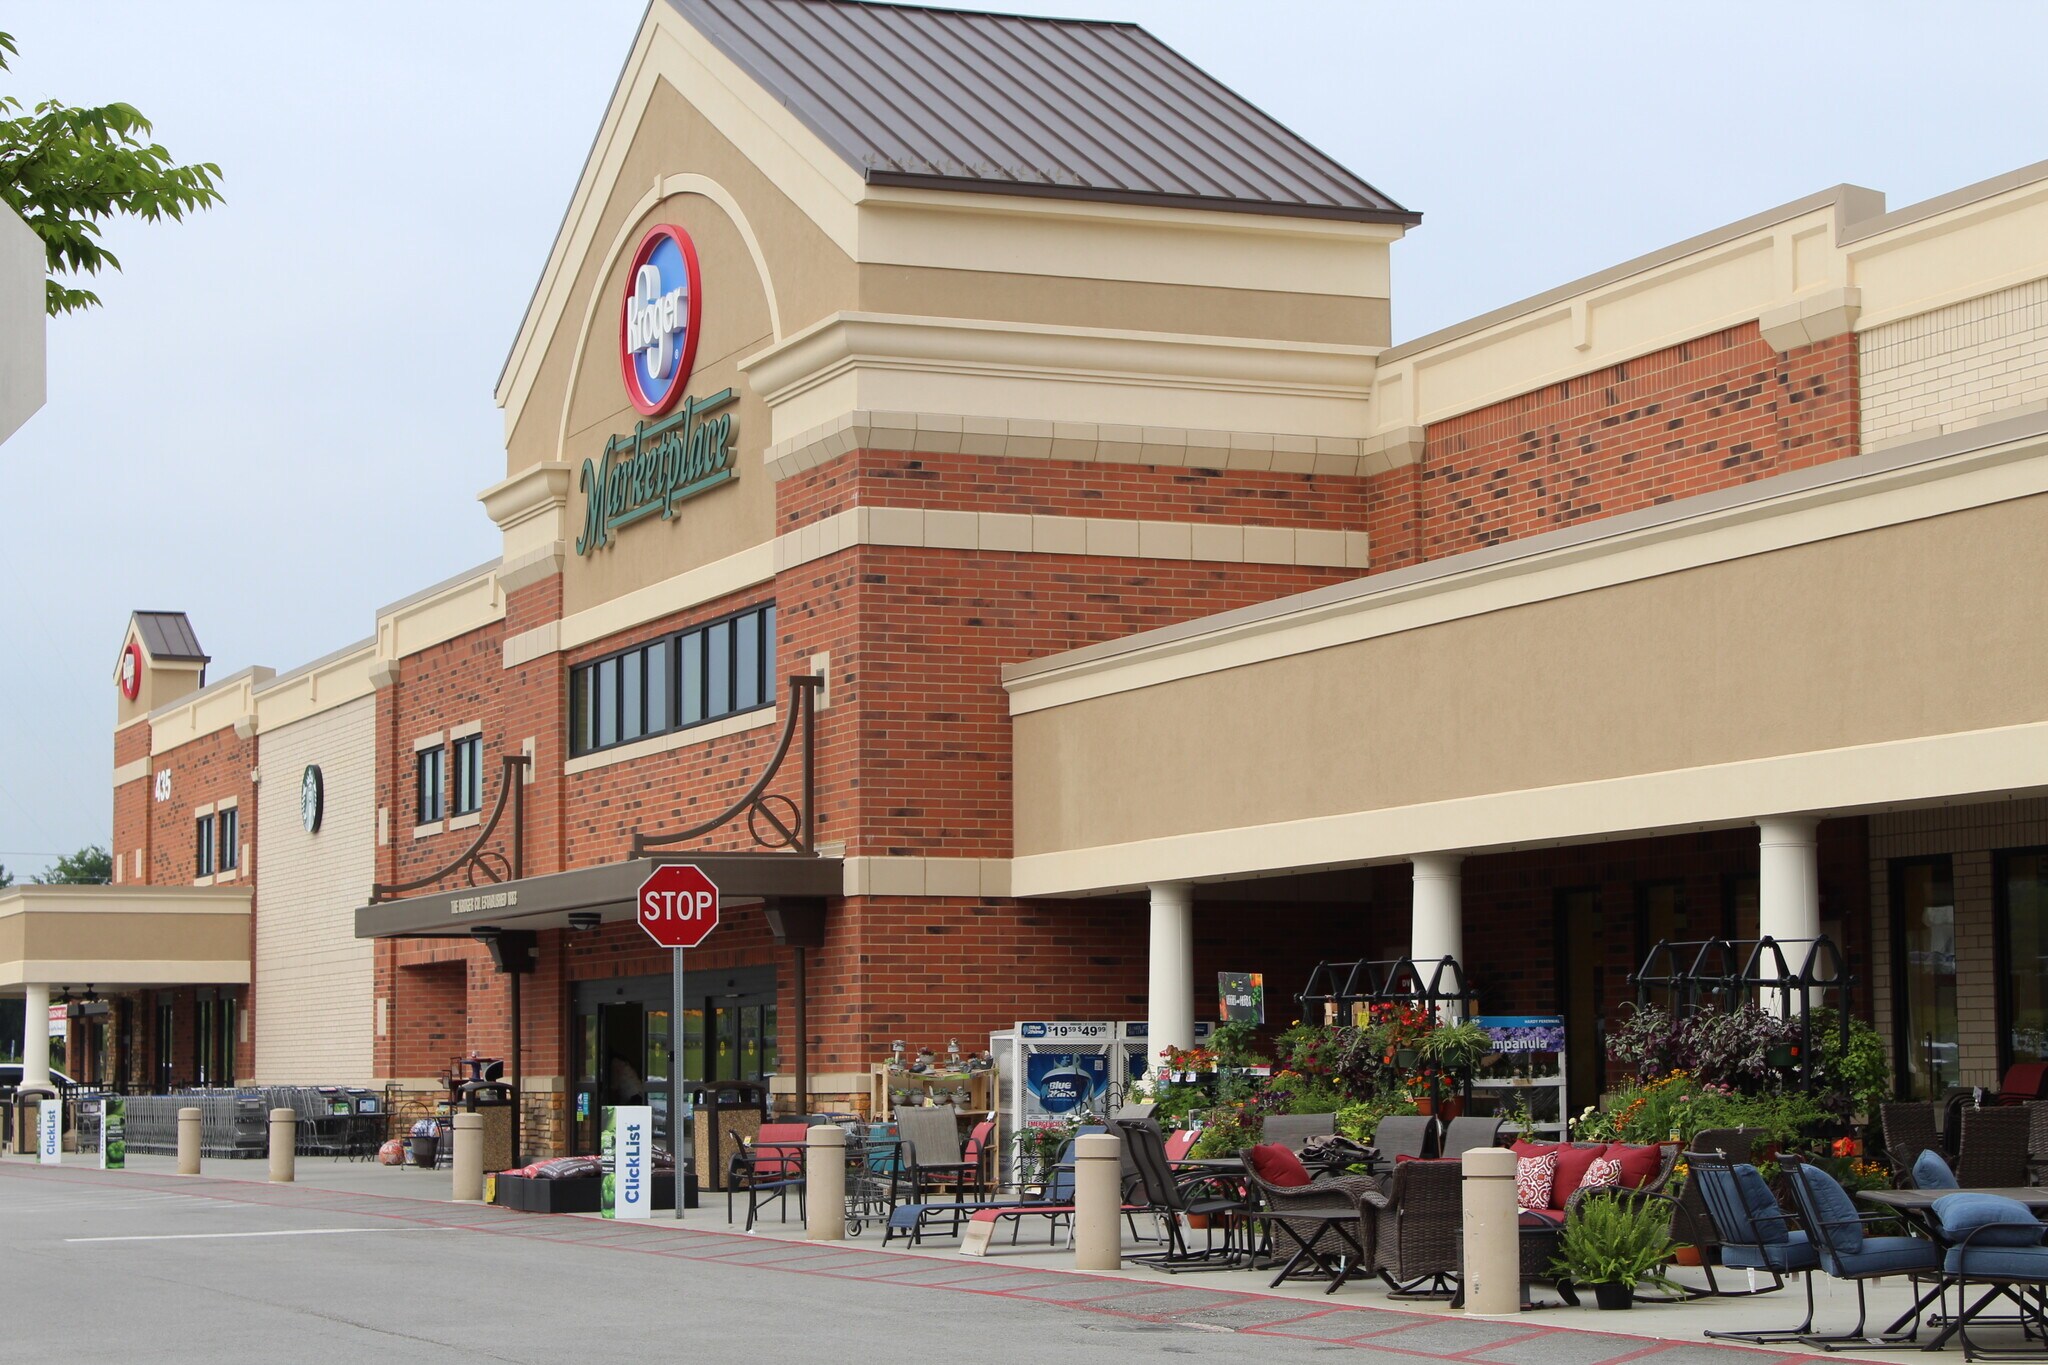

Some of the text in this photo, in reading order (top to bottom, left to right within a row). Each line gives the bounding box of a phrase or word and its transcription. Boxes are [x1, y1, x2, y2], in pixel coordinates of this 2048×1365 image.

[628, 264, 688, 379] Kroger
[576, 394, 733, 557] Marketplace
[155, 768, 171, 803] 435
[450, 900, 459, 914] THE
[644, 890, 713, 921] STOP
[1492, 1037, 1549, 1053] mpanula
[1049, 1080, 1072, 1089] Blue
[46, 1109, 56, 1155] ClickList
[624, 1124, 640, 1204] ClickList
